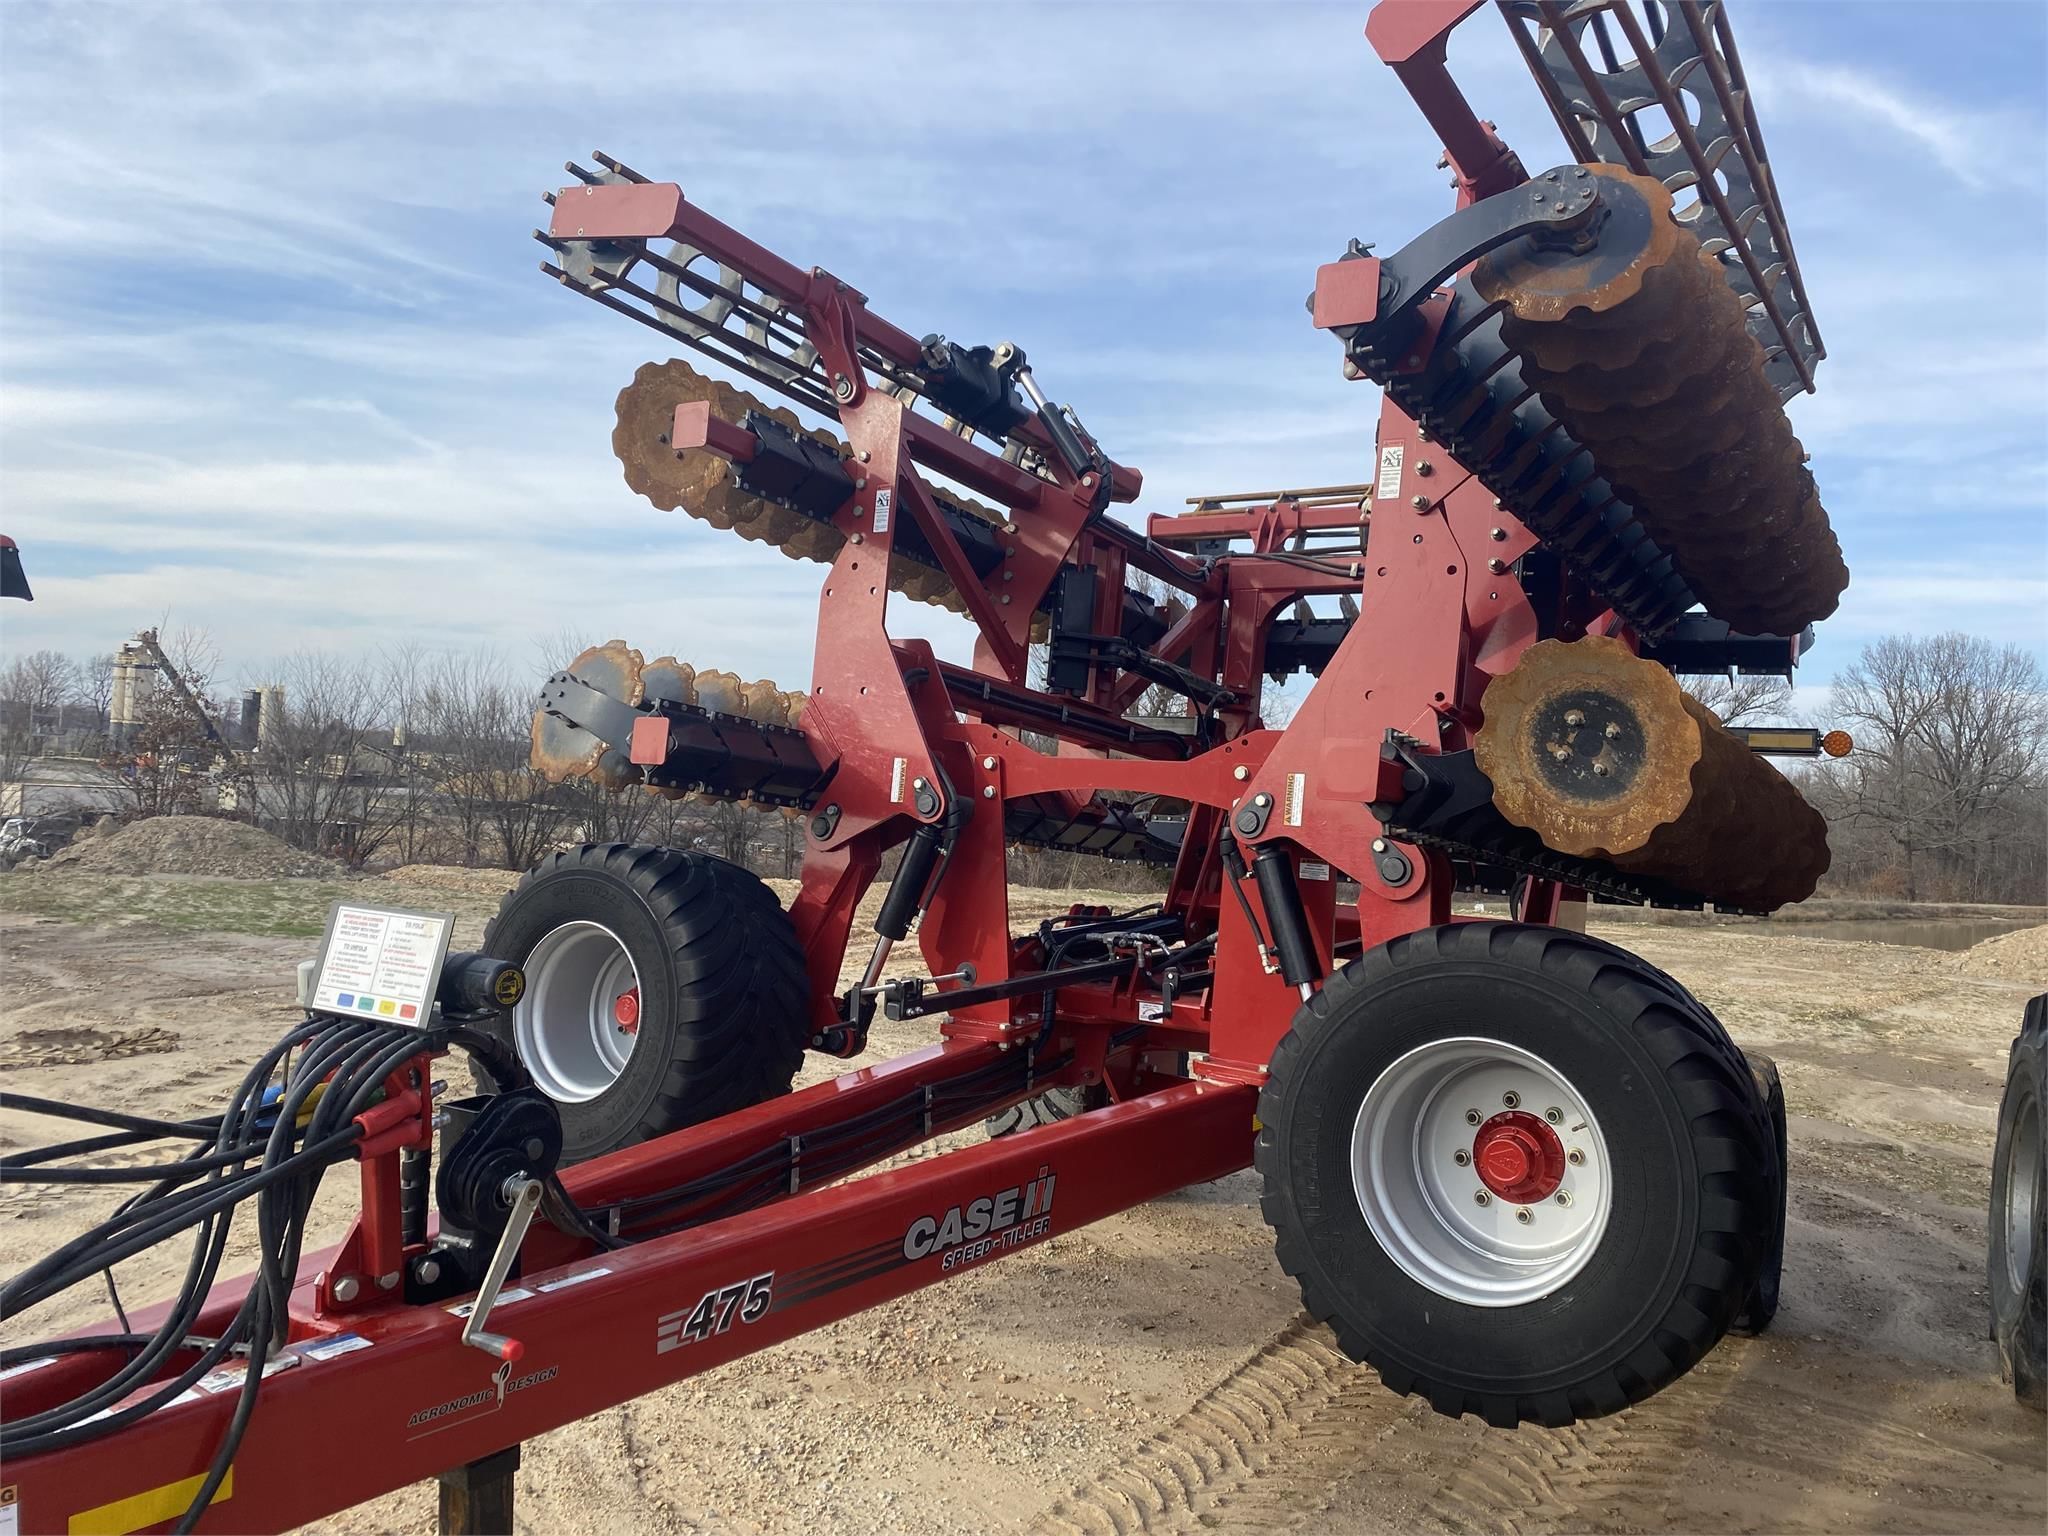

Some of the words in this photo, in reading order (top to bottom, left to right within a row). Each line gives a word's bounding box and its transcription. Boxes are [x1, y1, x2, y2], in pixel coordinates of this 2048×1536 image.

[1285, 775, 1295, 816] WARNING
[903, 1187, 1020, 1260] CASE
[942, 1215, 1052, 1272] SPEED-TILLER
[682, 1271, 775, 1341] 475
[407, 1388, 494, 1427] AGRONOMIC
[506, 1365, 560, 1394] DESIGN
